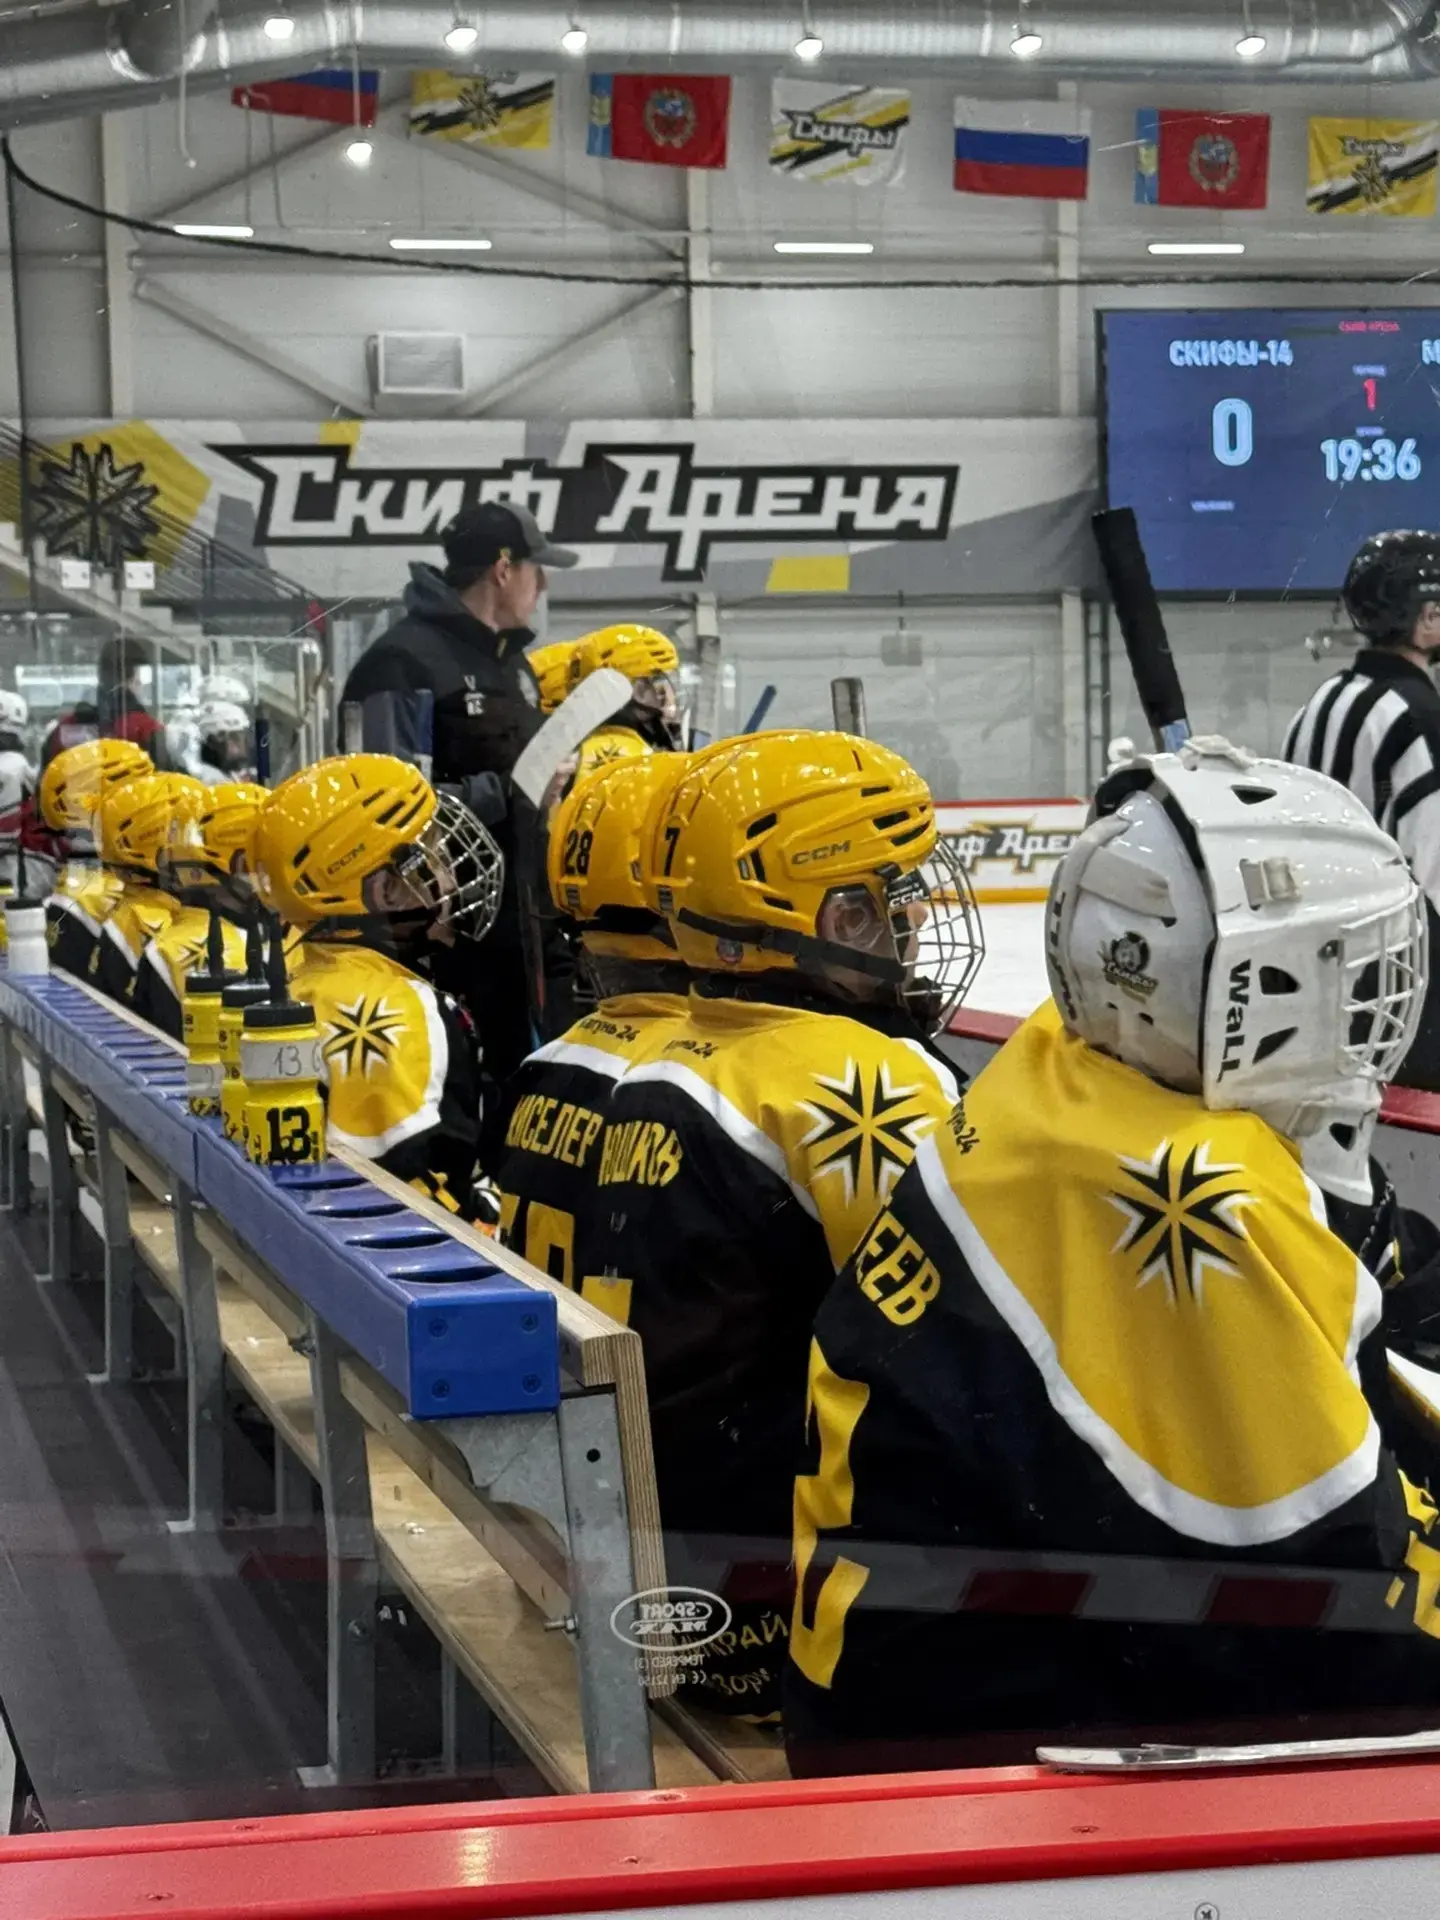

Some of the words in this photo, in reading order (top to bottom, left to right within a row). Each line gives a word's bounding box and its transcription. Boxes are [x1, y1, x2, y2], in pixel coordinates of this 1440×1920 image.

[1363, 378, 1377, 411] 1
[1212, 398, 1253, 466] 0
[1320, 438, 1421, 481] 19:36
[564, 829, 593, 875] 28
[664, 827, 681, 877] 7
[791, 839, 852, 865] CCM
[274, 1046, 302, 1077] 13
[266, 1106, 311, 1161] 13
